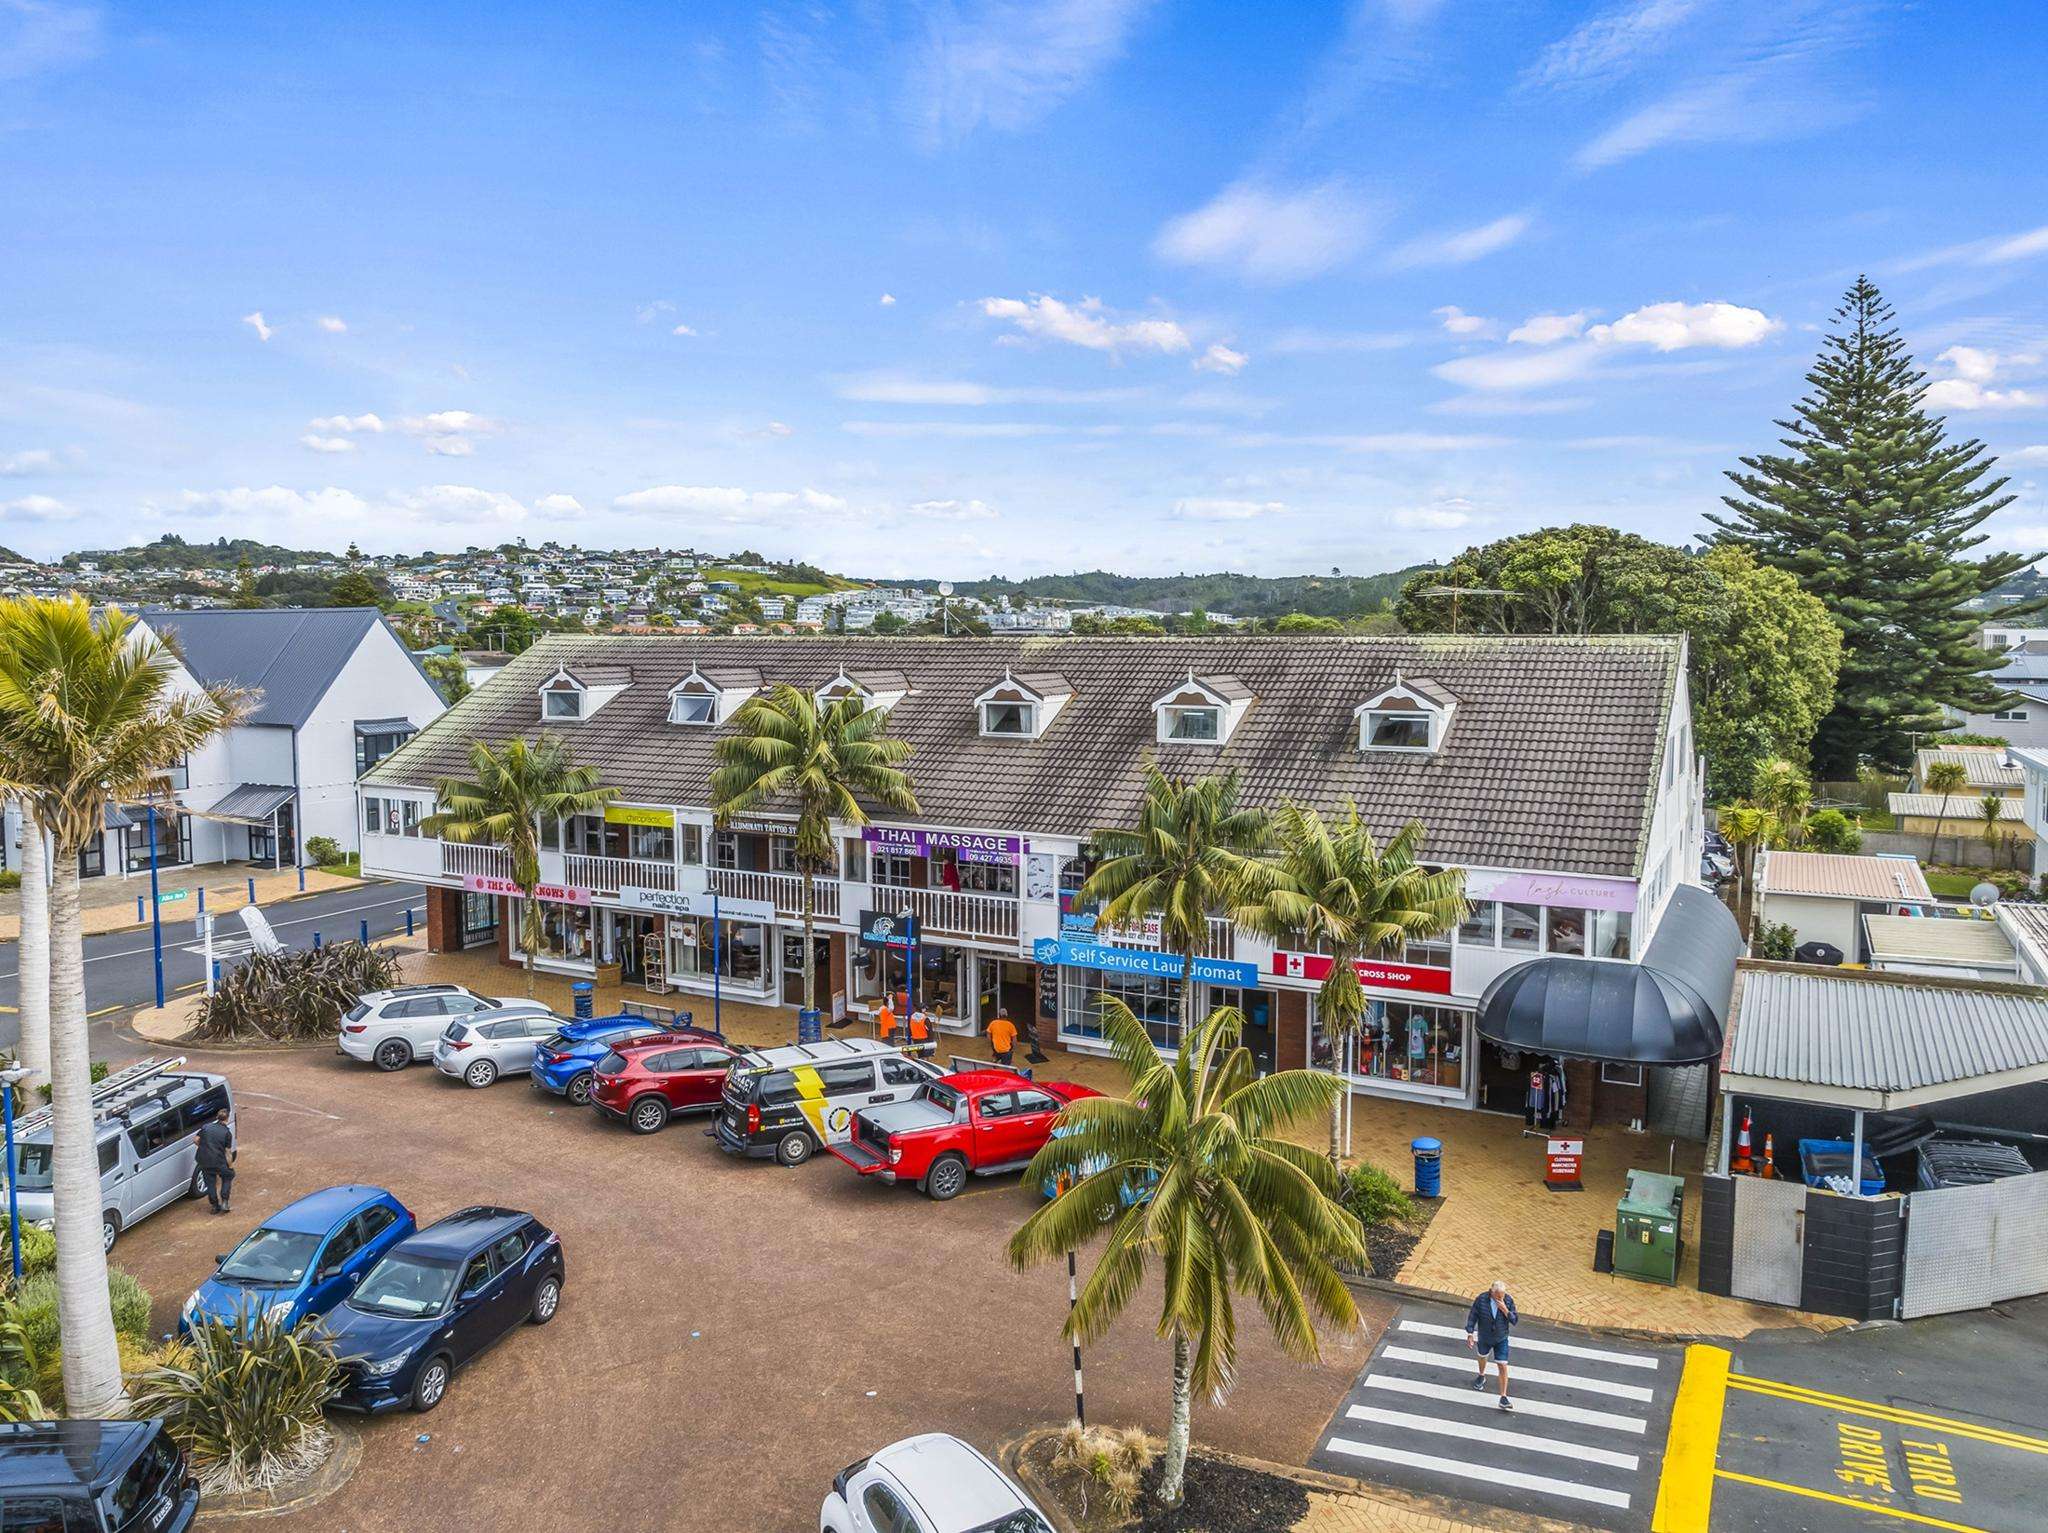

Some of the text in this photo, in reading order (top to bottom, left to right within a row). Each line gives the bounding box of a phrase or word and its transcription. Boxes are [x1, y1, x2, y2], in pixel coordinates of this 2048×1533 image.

[878, 828, 1008, 851] THAI MASSAGE
[487, 879, 503, 892] THE
[506, 882, 525, 895] GU
[1569, 887, 1617, 899] CULTURE
[639, 891, 690, 906] perfection
[1070, 947, 1096, 963] Self
[1099, 950, 1149, 970] Service
[1358, 968, 1385, 979] CROSS
[1387, 970, 1412, 982] SHOP
[1834, 1422, 1896, 1494] DRIVE
[1901, 1439, 1963, 1504] THRU
